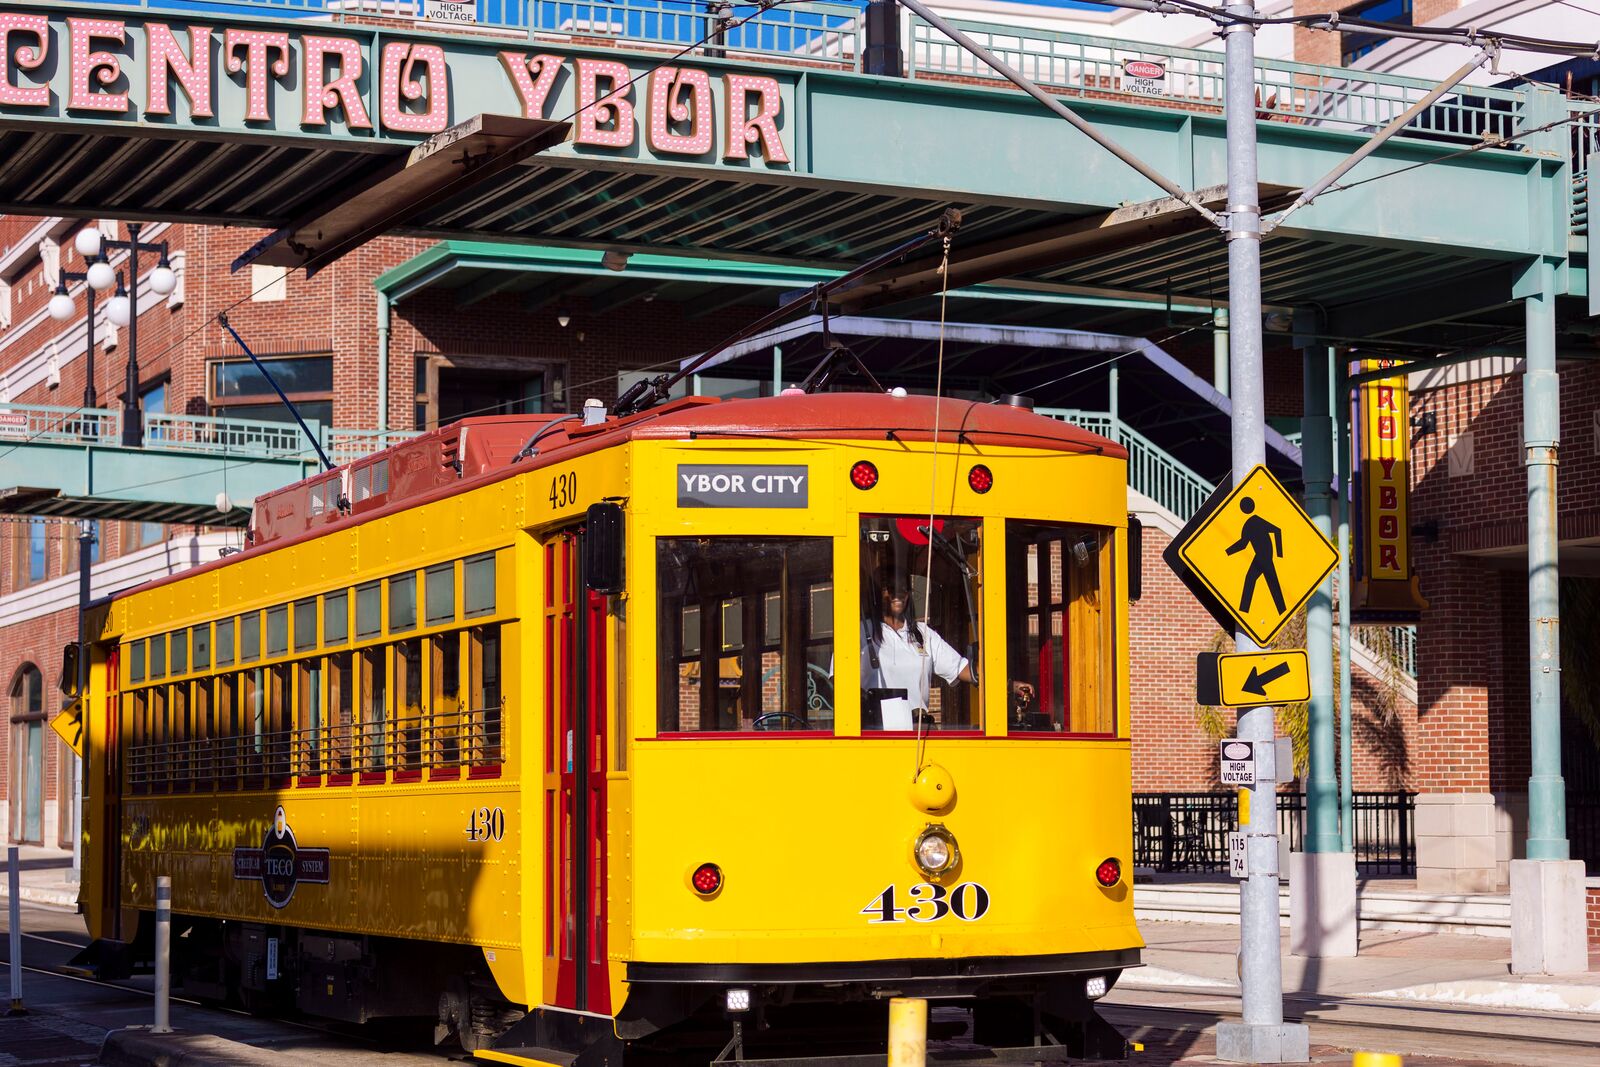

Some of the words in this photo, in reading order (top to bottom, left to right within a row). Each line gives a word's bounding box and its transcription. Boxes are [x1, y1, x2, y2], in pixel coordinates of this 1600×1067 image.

[440, 3, 463, 12] HIGH
[430, 10, 473, 22] VOLTAGE
[1127, 64, 1161, 75] DANGER
[0, 12, 449, 134] CENTRO
[497, 51, 791, 164] YBOR
[1134, 78, 1154, 87] HIGH
[1126, 85, 1162, 95] VOLTAGE
[549, 471, 577, 510] 430
[681, 474, 746, 493] YBOR
[751, 475, 804, 494] CITY
[1378, 456, 1400, 572] YBOR
[1229, 763, 1246, 771] HIGH
[1222, 772, 1253, 782] VOLTAGE
[465, 806, 506, 843] 430
[1231, 838, 1245, 851] 115
[264, 858, 294, 877] TECO
[1234, 858, 1244, 871] 74
[859, 881, 990, 923] 430
